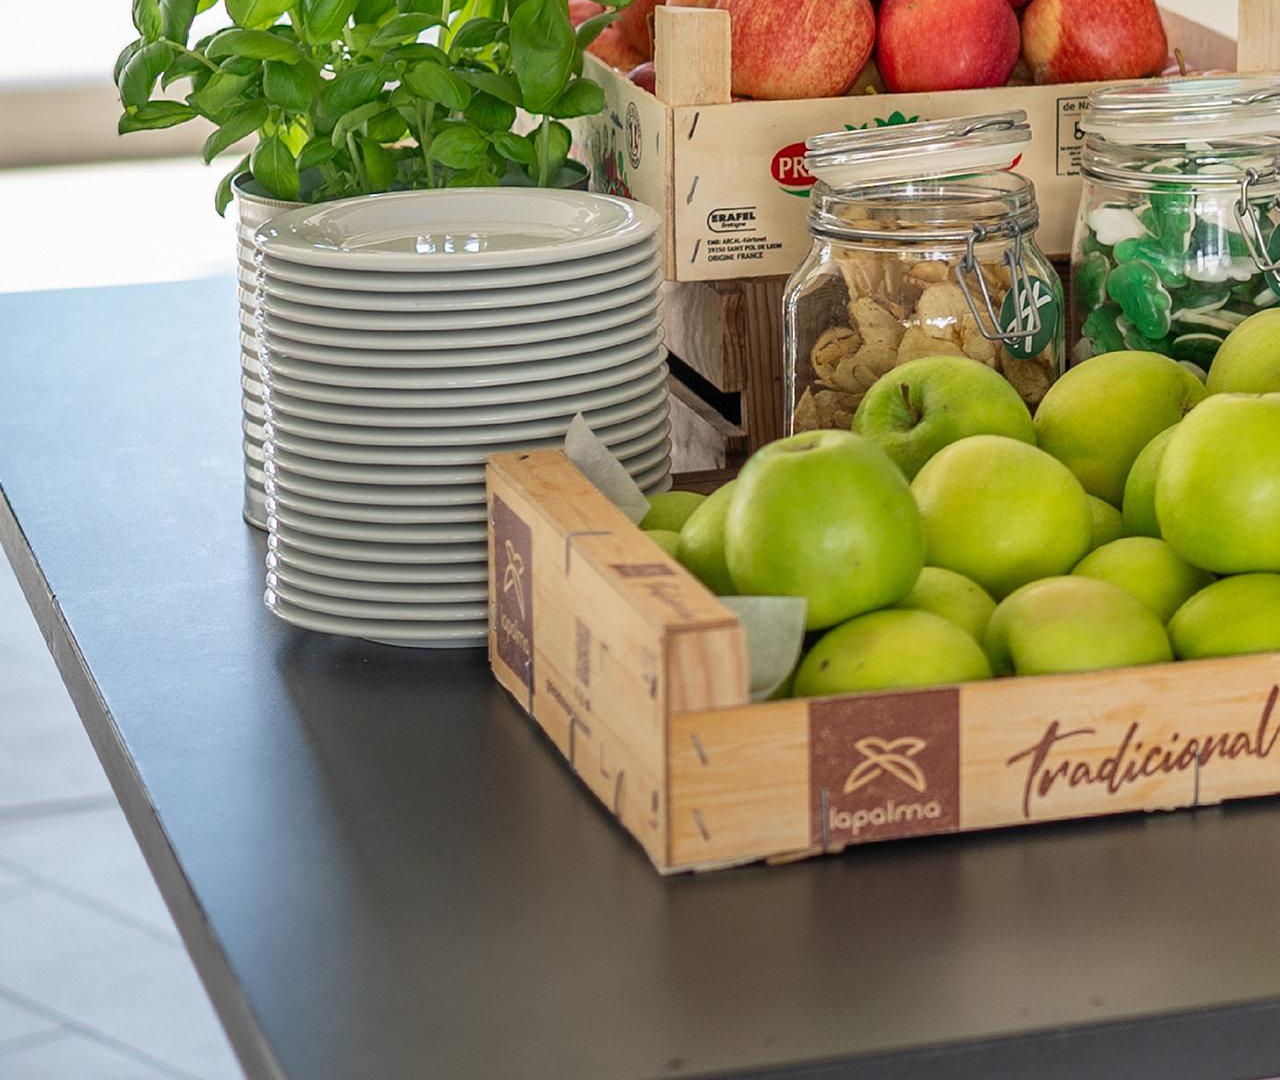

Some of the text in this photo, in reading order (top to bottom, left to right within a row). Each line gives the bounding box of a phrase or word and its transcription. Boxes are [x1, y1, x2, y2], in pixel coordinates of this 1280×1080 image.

[779, 156, 809, 179] PR
[711, 212, 756, 223] ERAFEL
[708, 252, 763, 262] ORIGINE FRANCE
[829, 799, 942, 836] lapalma
